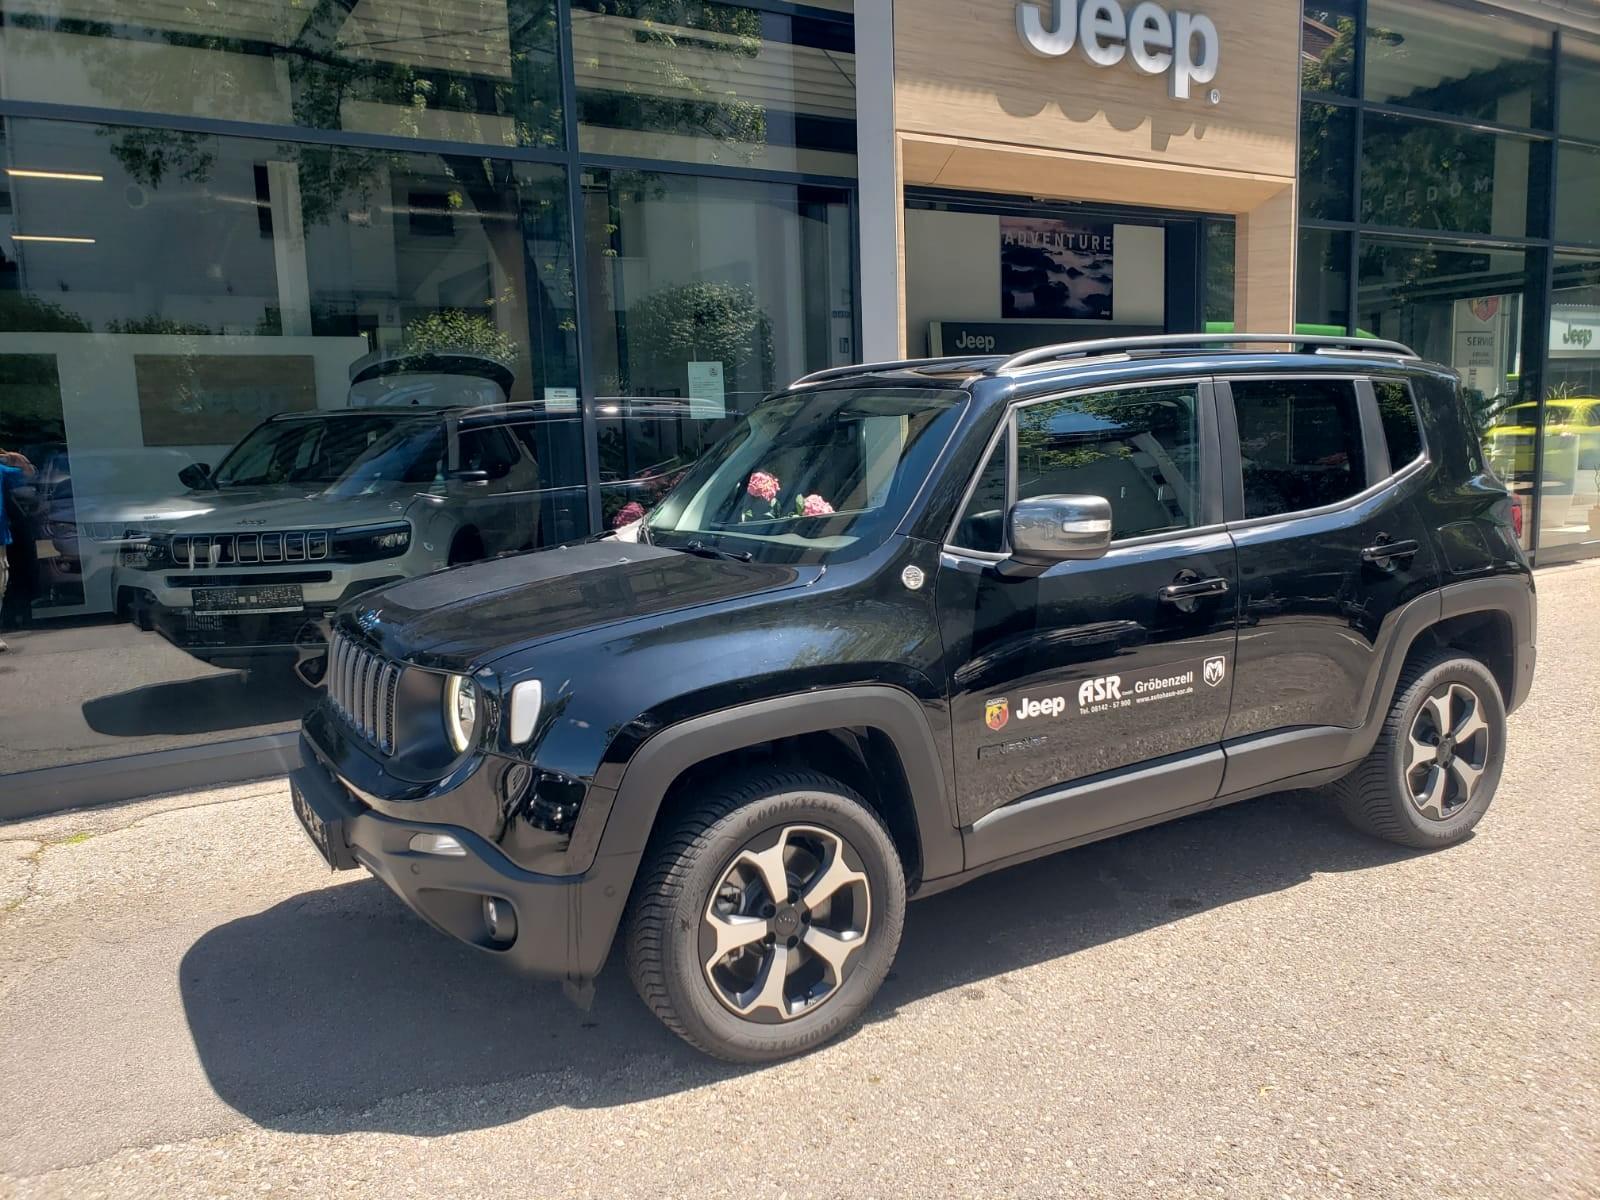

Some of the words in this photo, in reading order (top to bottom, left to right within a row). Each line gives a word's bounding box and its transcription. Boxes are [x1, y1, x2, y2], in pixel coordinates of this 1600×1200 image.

[1016, 0, 1219, 100] Jeep
[1004, 231, 1111, 250] ADVENTURE
[956, 331, 995, 352] Jeep
[1563, 322, 1593, 349] Jeep
[1078, 675, 1122, 706] ASR
[1134, 671, 1194, 694] Gröbenzell
[1016, 696, 1065, 719] Jeep
